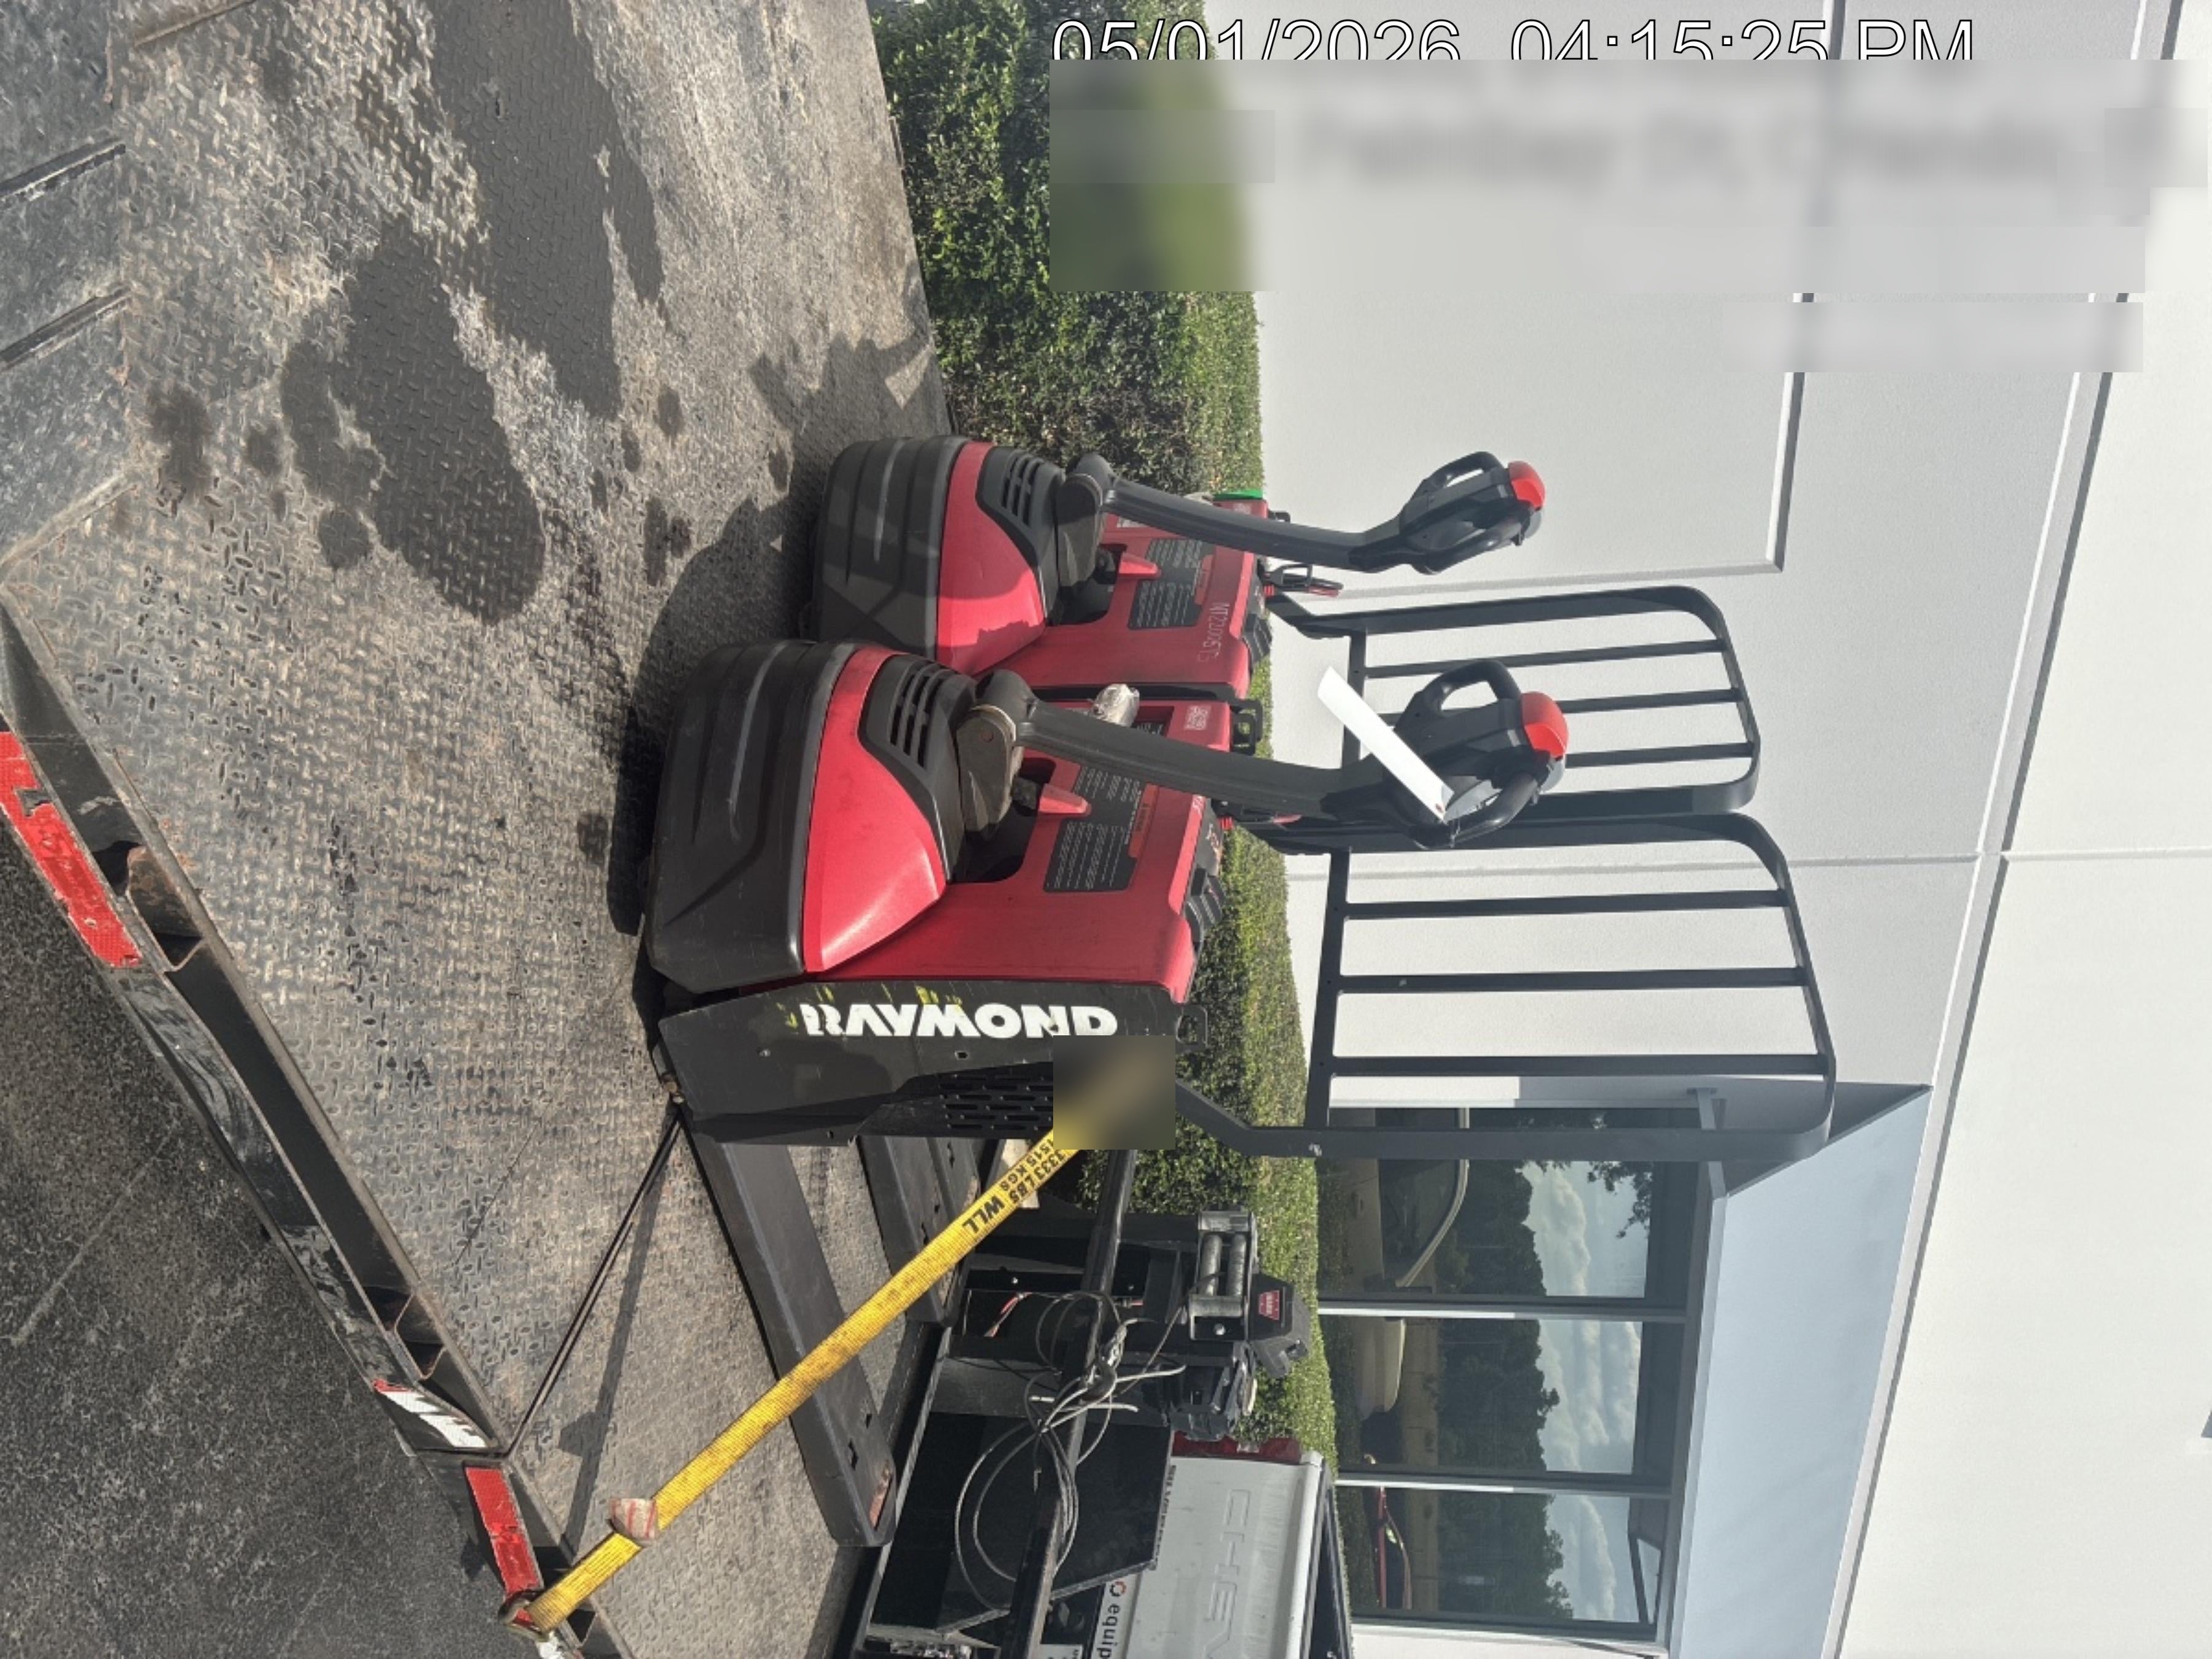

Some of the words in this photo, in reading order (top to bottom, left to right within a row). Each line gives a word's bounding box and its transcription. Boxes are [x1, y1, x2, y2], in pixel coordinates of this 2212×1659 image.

[799, 1003, 1118, 1038] RAYMOND
[999, 1164, 1028, 1191] KGS
[1034, 1150, 1066, 1179] 3333
[1009, 1174, 1037, 1203] LBS
[962, 1195, 1006, 1235] WLL
